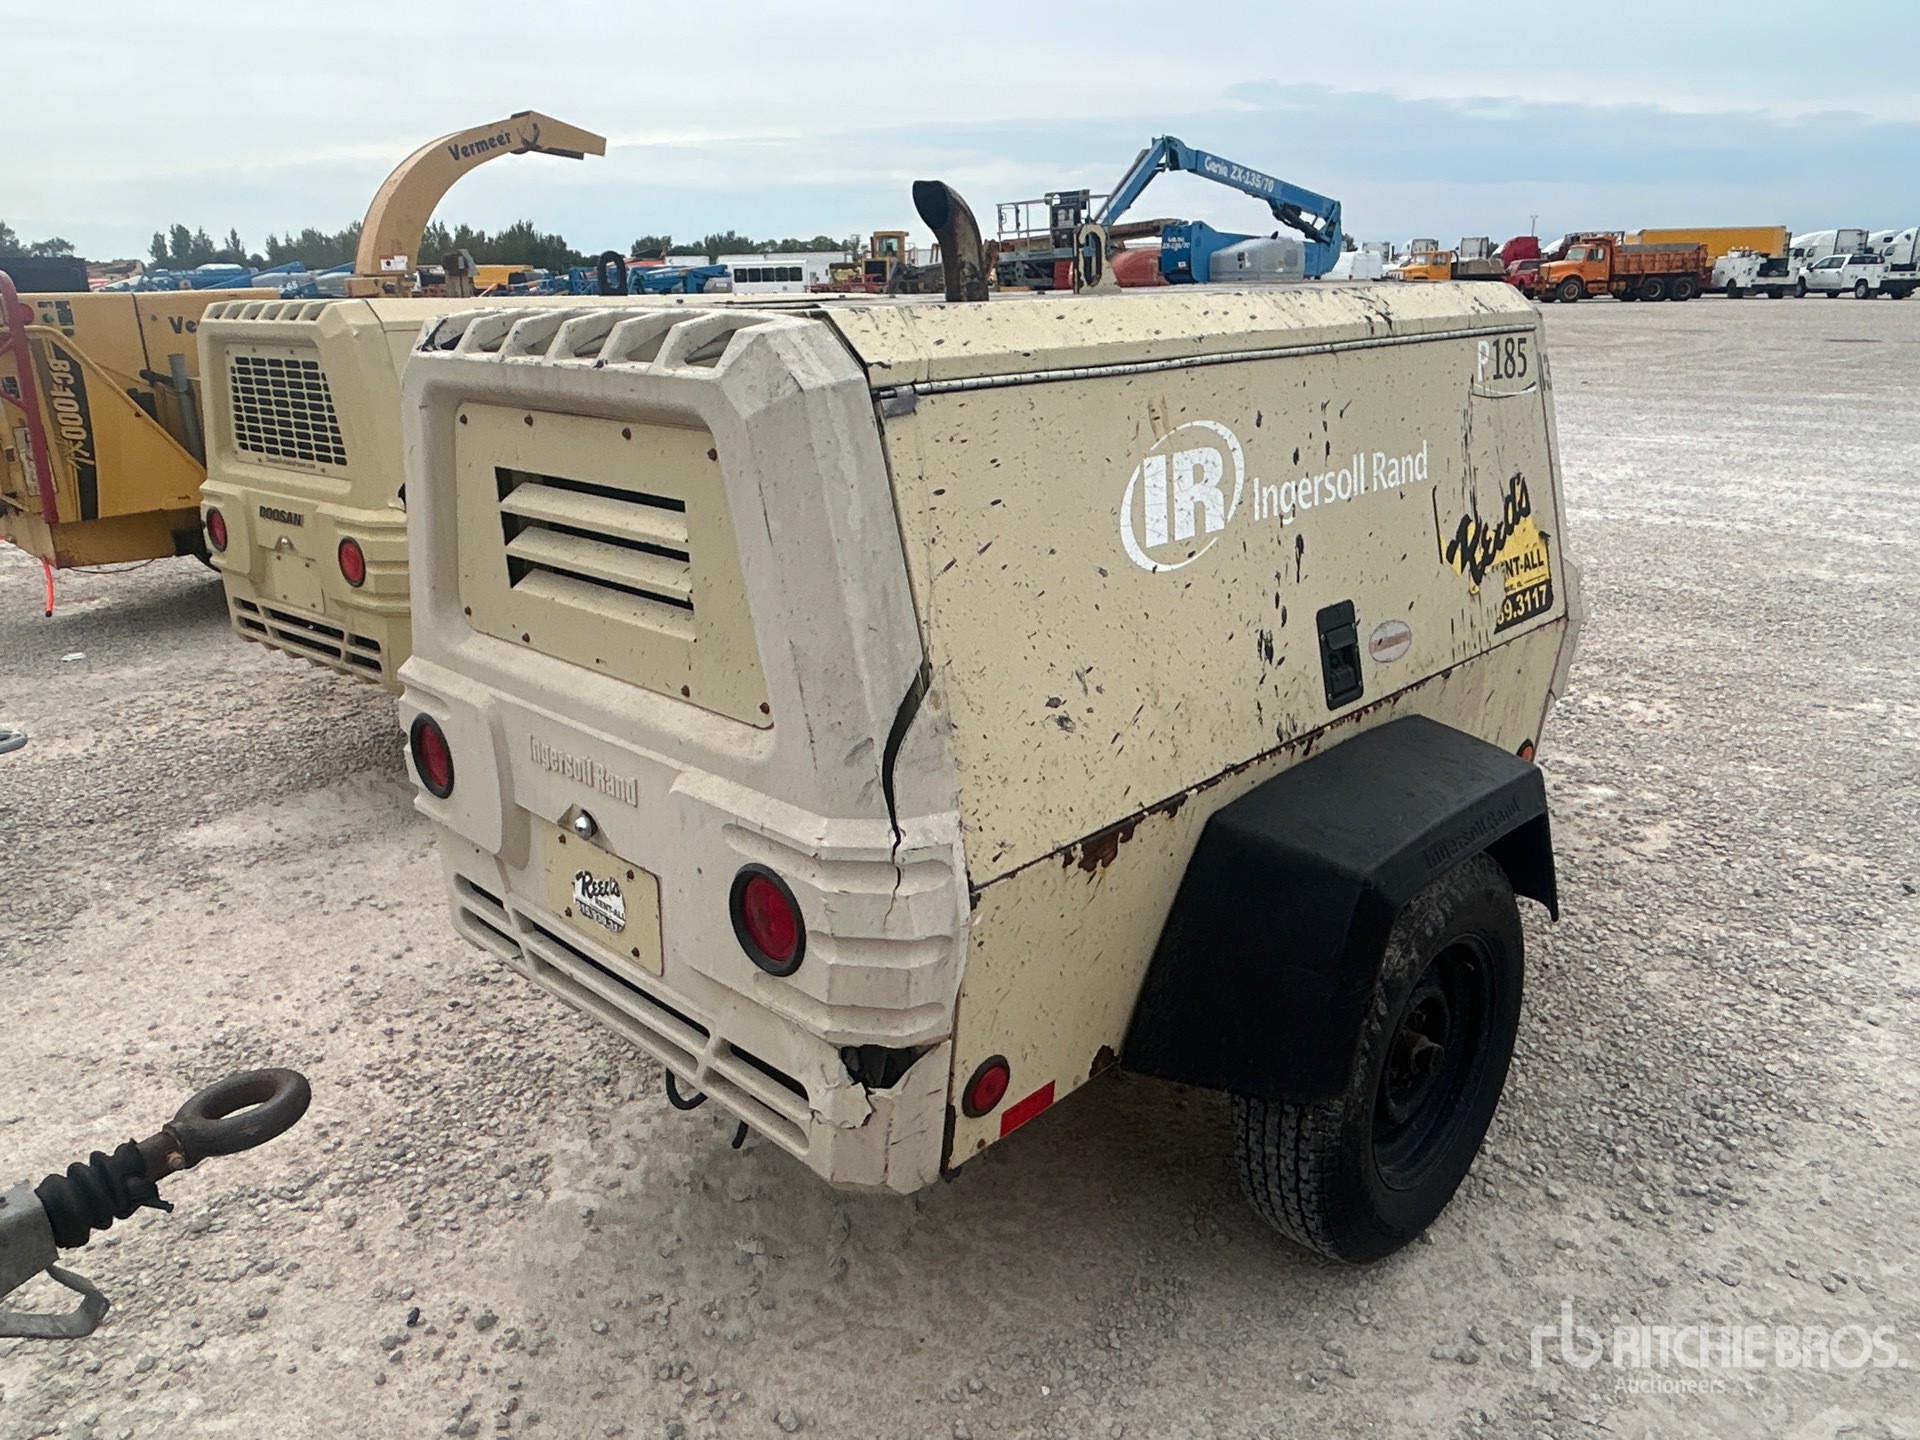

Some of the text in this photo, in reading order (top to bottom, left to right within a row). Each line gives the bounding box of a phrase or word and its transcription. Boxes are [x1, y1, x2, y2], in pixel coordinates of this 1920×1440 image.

[448, 132, 512, 161] Vermeer
[1205, 156, 1275, 193] Genie ZX-135/70
[1143, 447, 1225, 548] IR
[1253, 439, 1428, 526] Ingersoll Rand
[259, 505, 304, 527] DOOSAN
[528, 732, 638, 808] Ingersoll Rand
